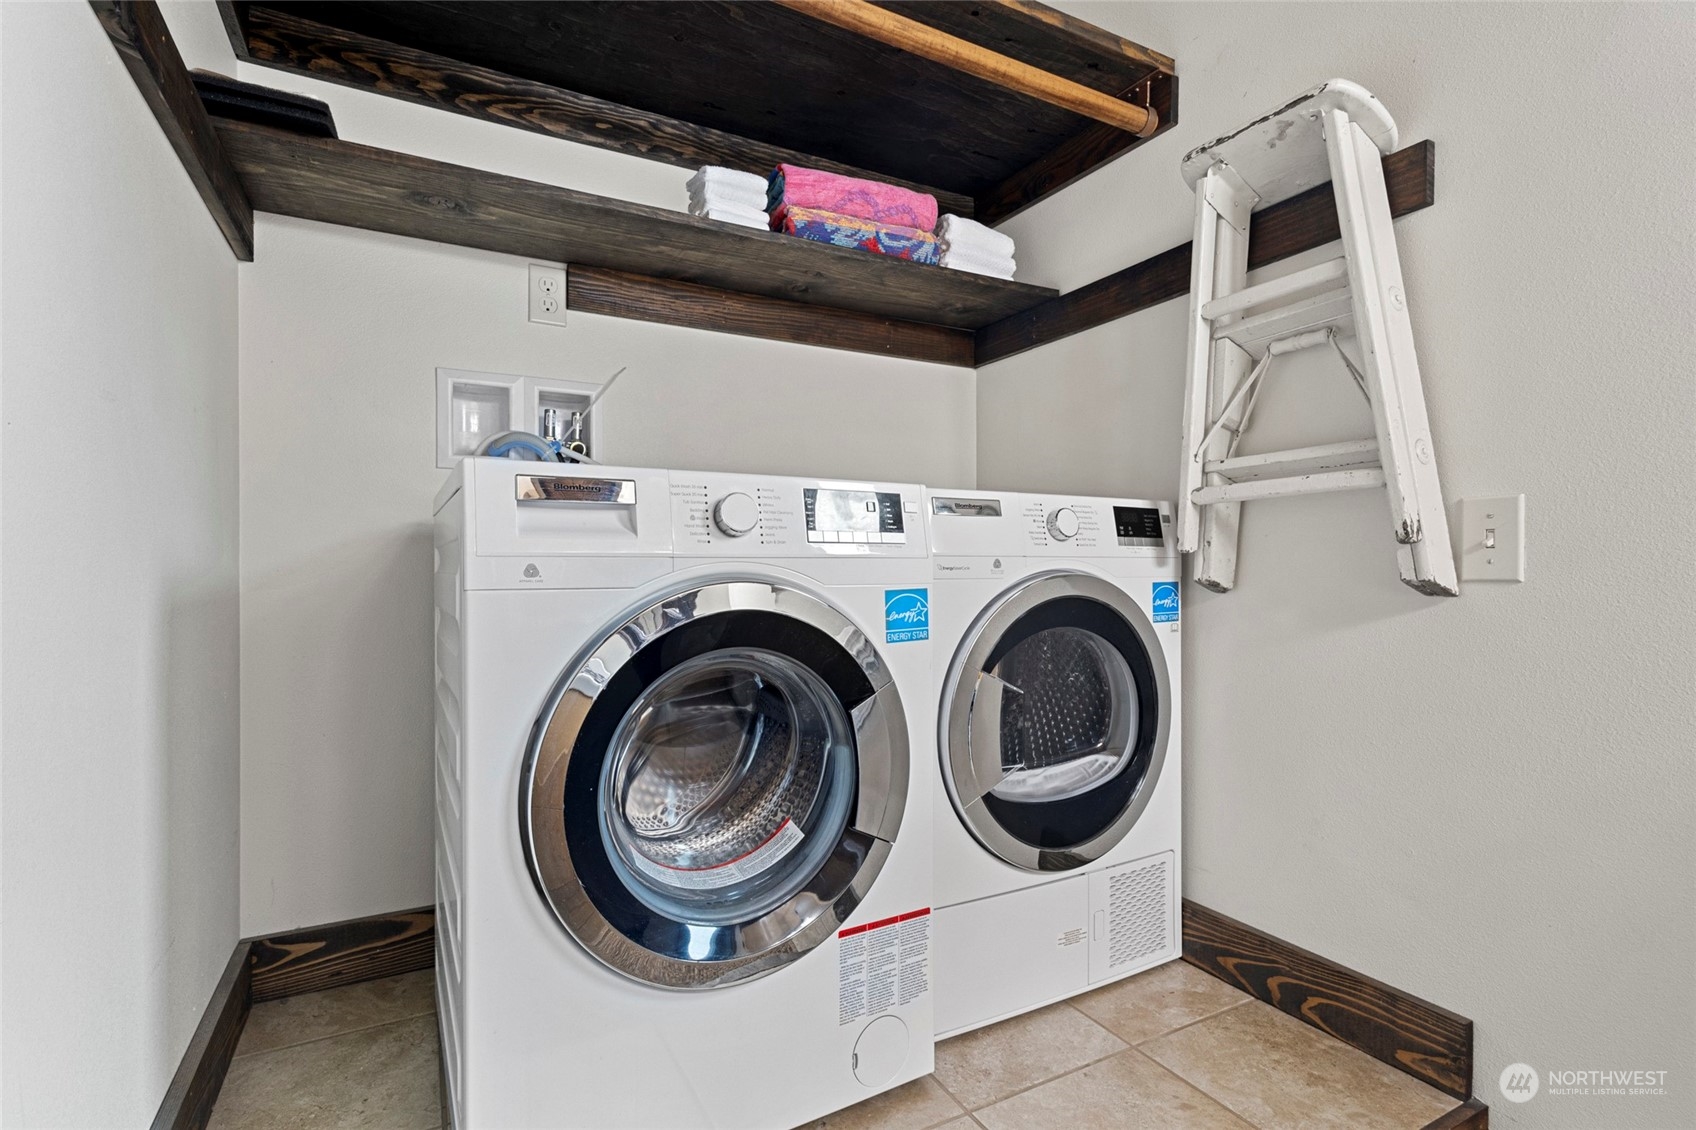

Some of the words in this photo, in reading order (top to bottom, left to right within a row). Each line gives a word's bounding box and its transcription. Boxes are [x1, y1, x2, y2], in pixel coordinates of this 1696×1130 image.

[554, 482, 601, 492] Blomberg
[887, 632, 911, 641] ENERGY
[912, 630, 927, 640] STAR
